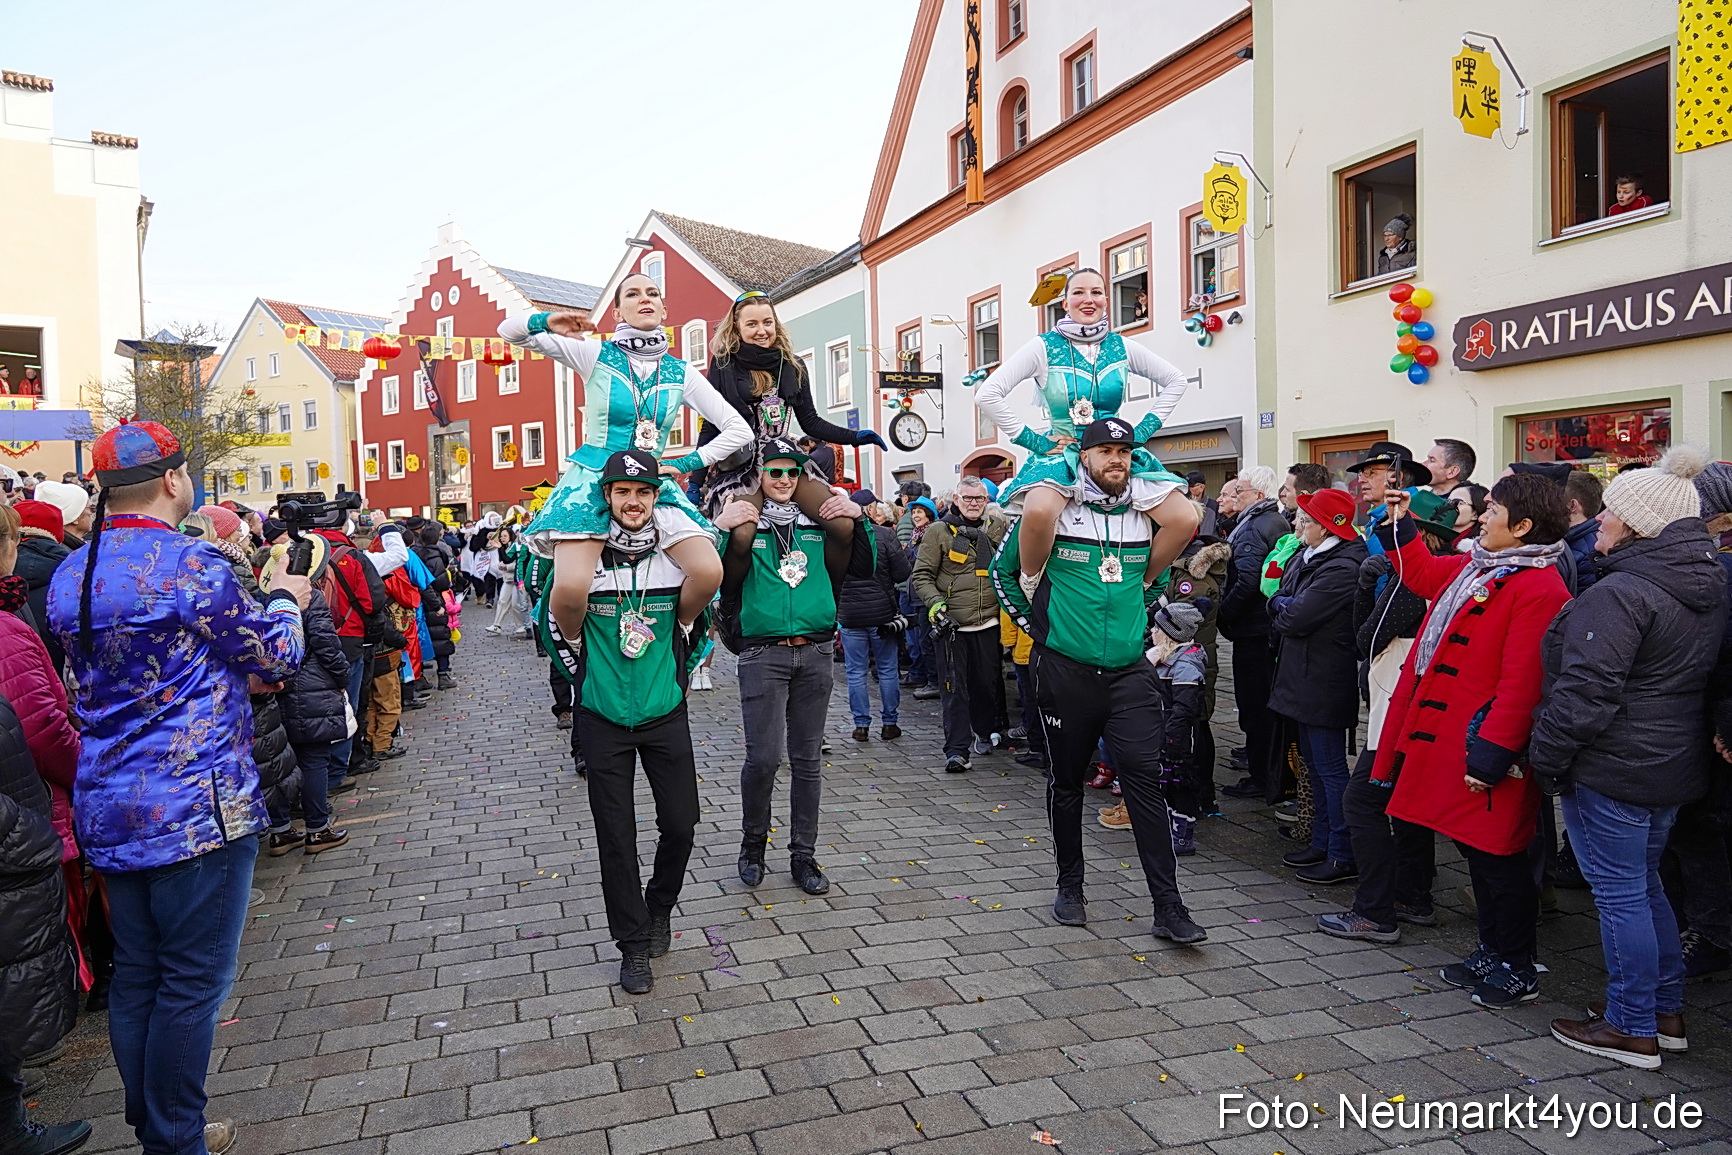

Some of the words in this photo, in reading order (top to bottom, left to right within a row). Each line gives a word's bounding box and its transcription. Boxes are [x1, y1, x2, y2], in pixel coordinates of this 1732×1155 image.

[1501, 288, 1676, 353] RATHAUS
[1176, 437, 1220, 452] UHREN
[1045, 714, 1062, 729] VM
